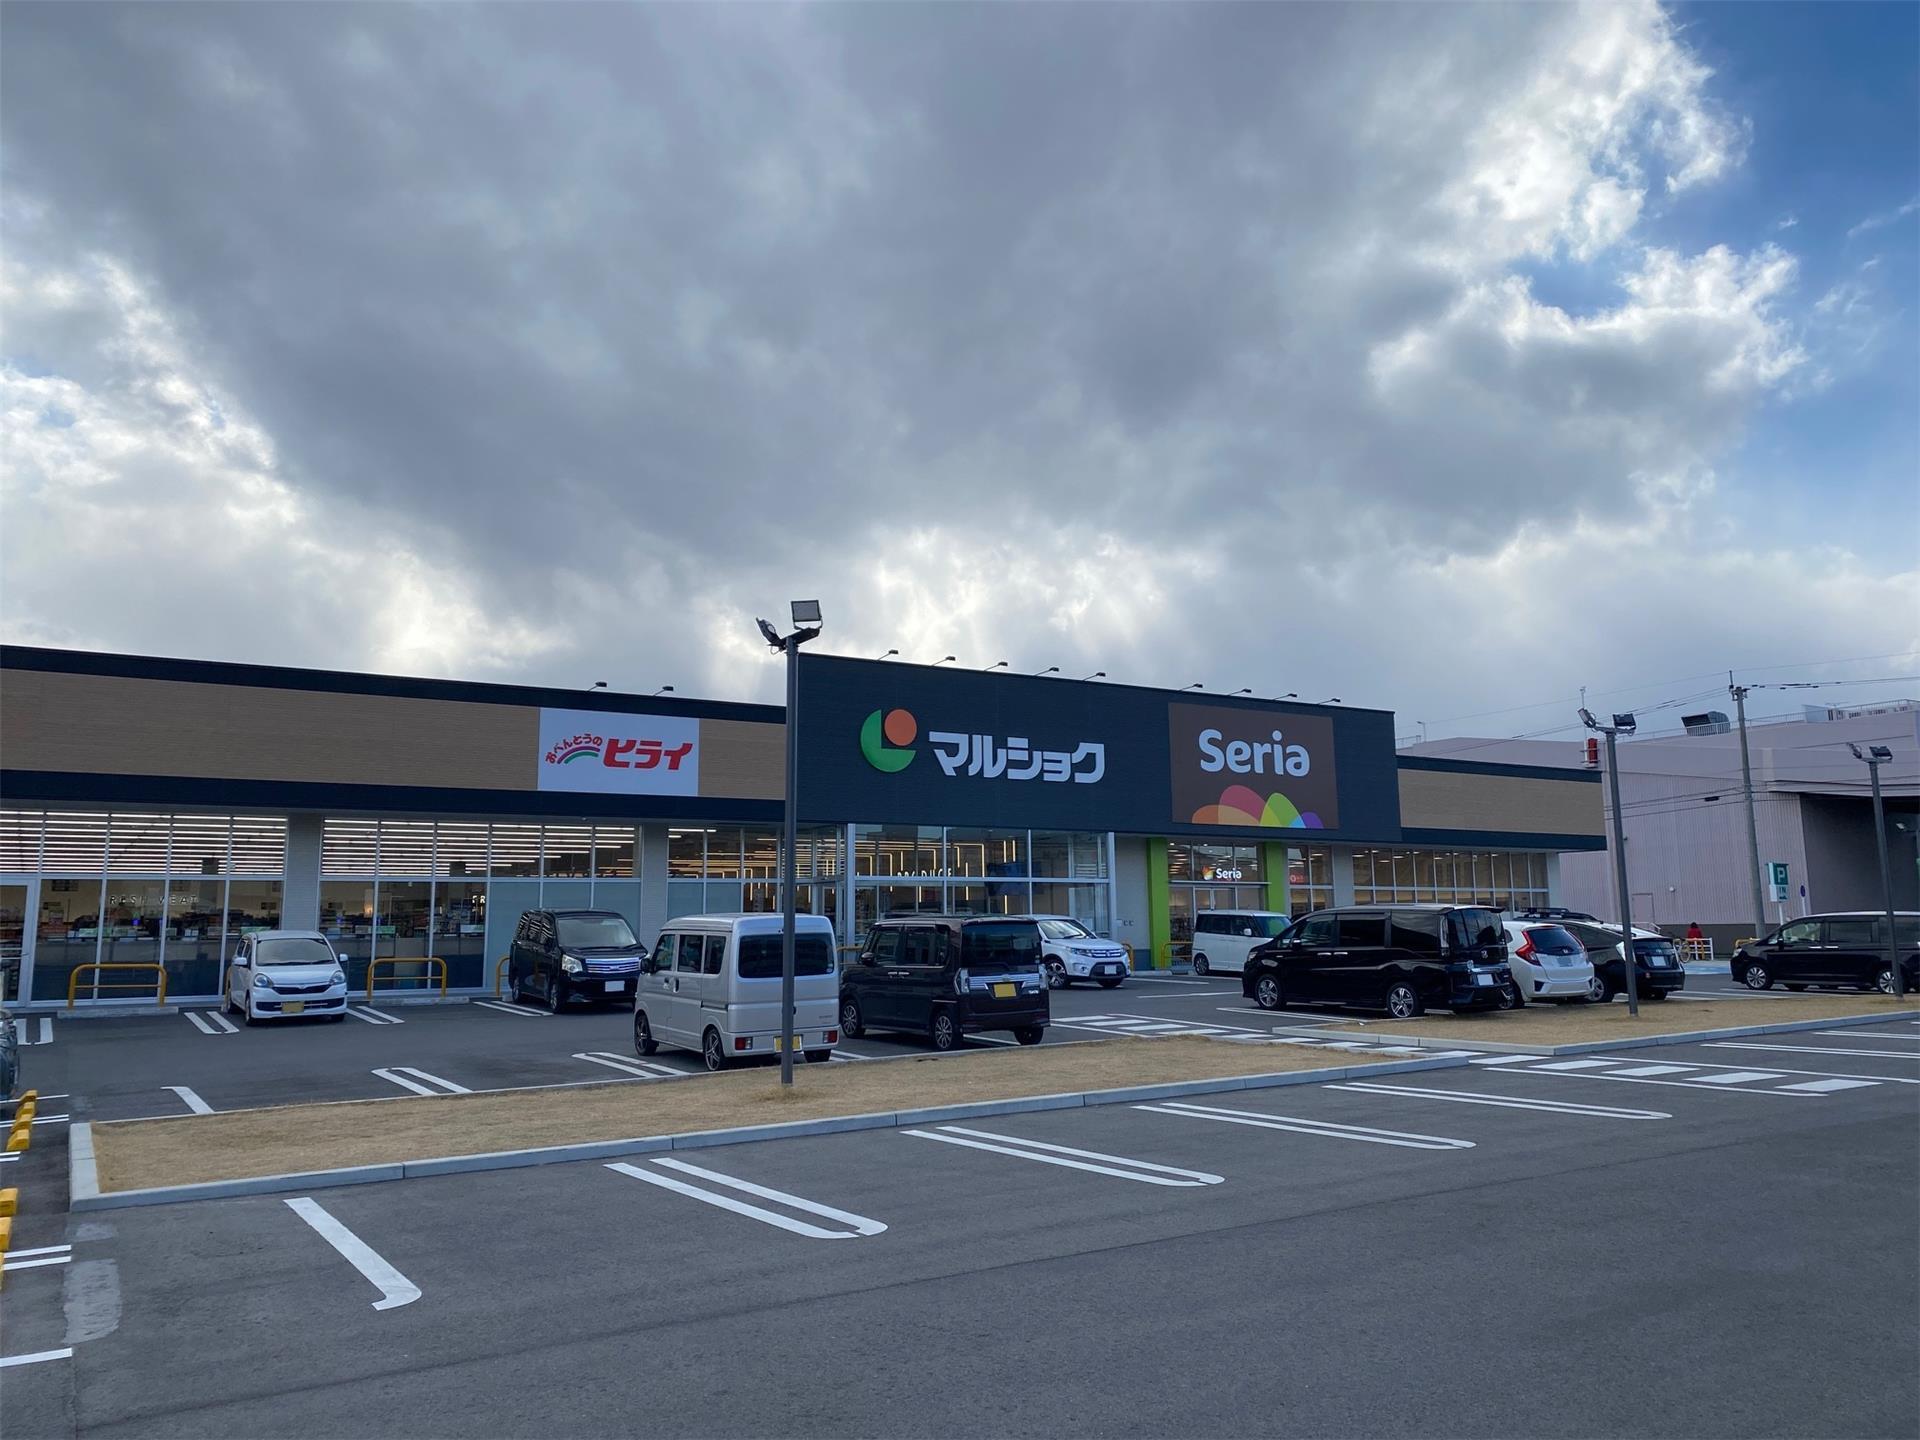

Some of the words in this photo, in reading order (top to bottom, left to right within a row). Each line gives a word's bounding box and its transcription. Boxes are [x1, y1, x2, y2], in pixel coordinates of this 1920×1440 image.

[603, 738, 693, 770] ヒライ
[928, 731, 1105, 784] マルショク
[1198, 728, 1310, 777] Seria
[1216, 867, 1242, 879] Seria
[1777, 867, 1785, 883] P
